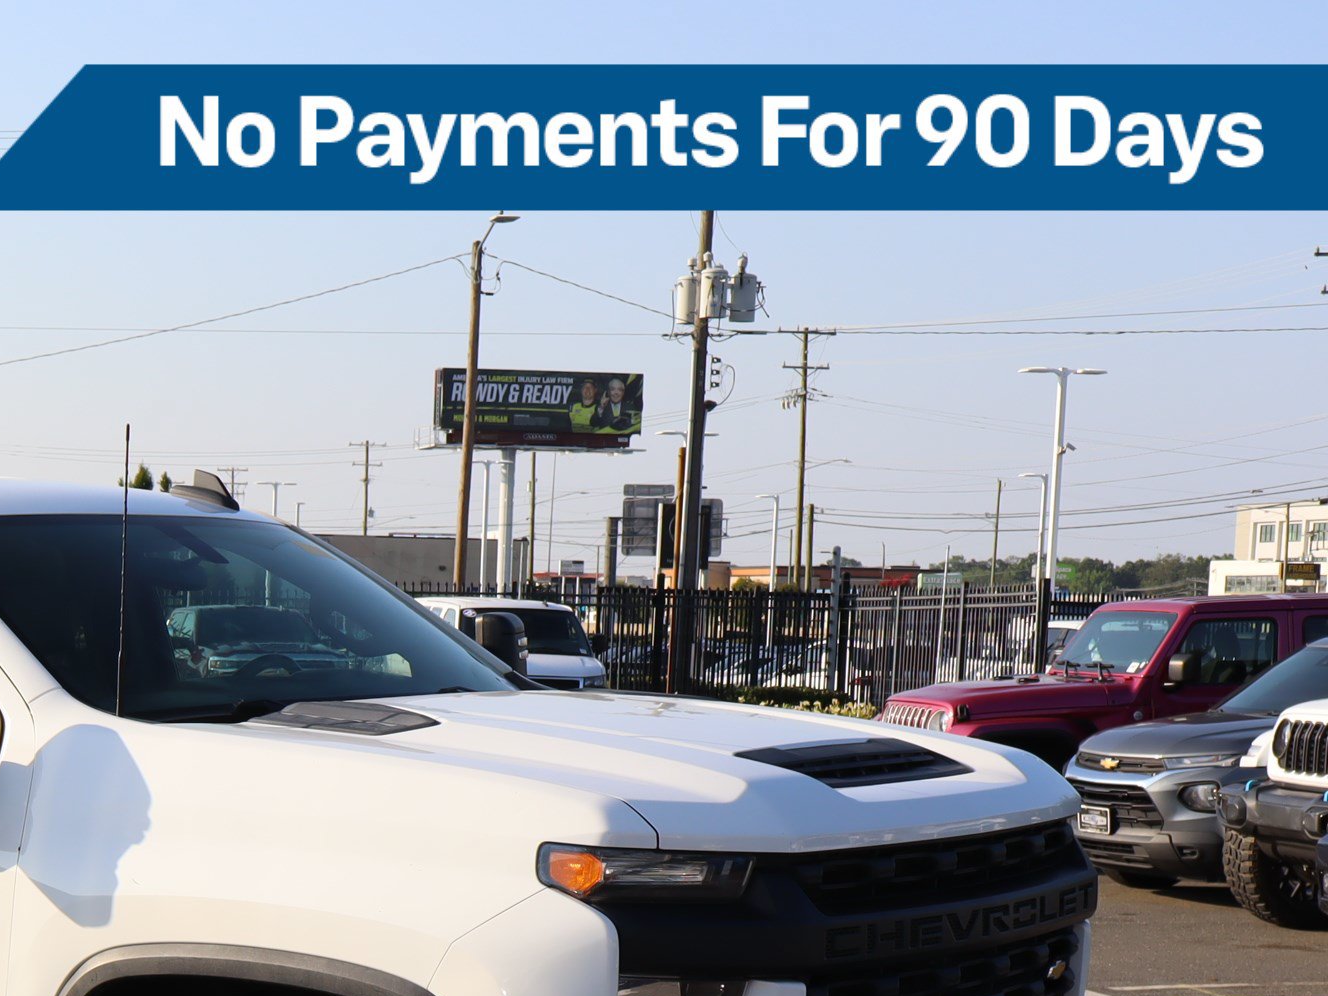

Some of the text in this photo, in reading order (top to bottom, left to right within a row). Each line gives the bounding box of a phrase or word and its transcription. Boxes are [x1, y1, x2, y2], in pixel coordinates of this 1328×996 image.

[508, 383, 520, 403] &
[522, 384, 572, 404] READY
[824, 885, 1094, 960] CHEVROLET
